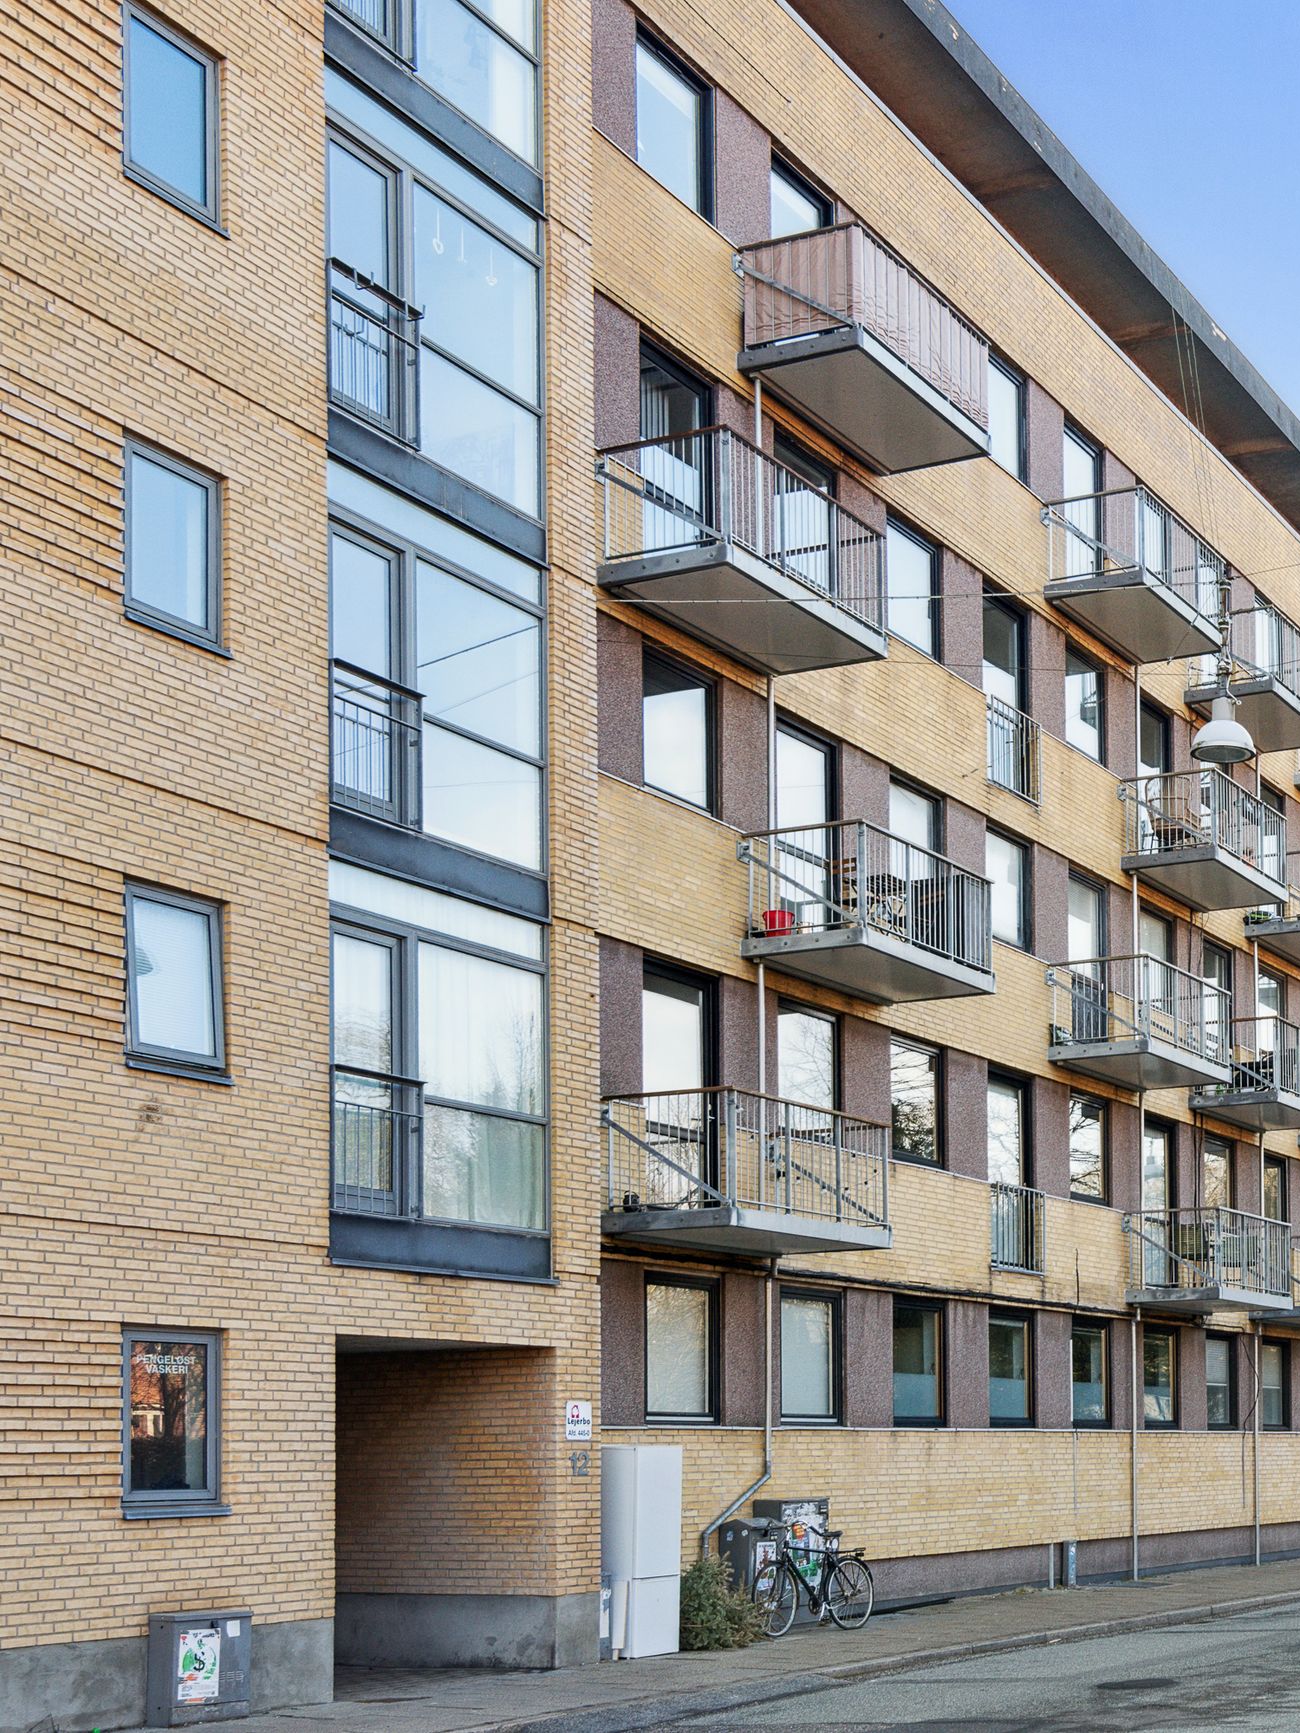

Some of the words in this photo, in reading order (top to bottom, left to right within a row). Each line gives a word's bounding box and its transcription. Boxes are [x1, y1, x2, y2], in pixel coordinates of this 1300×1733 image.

[136, 1354, 197, 1365] PENGELØST
[145, 1365, 188, 1374] VASKERI
[567, 1417, 591, 1426] Lejerbo
[568, 1451, 590, 1476] 12
